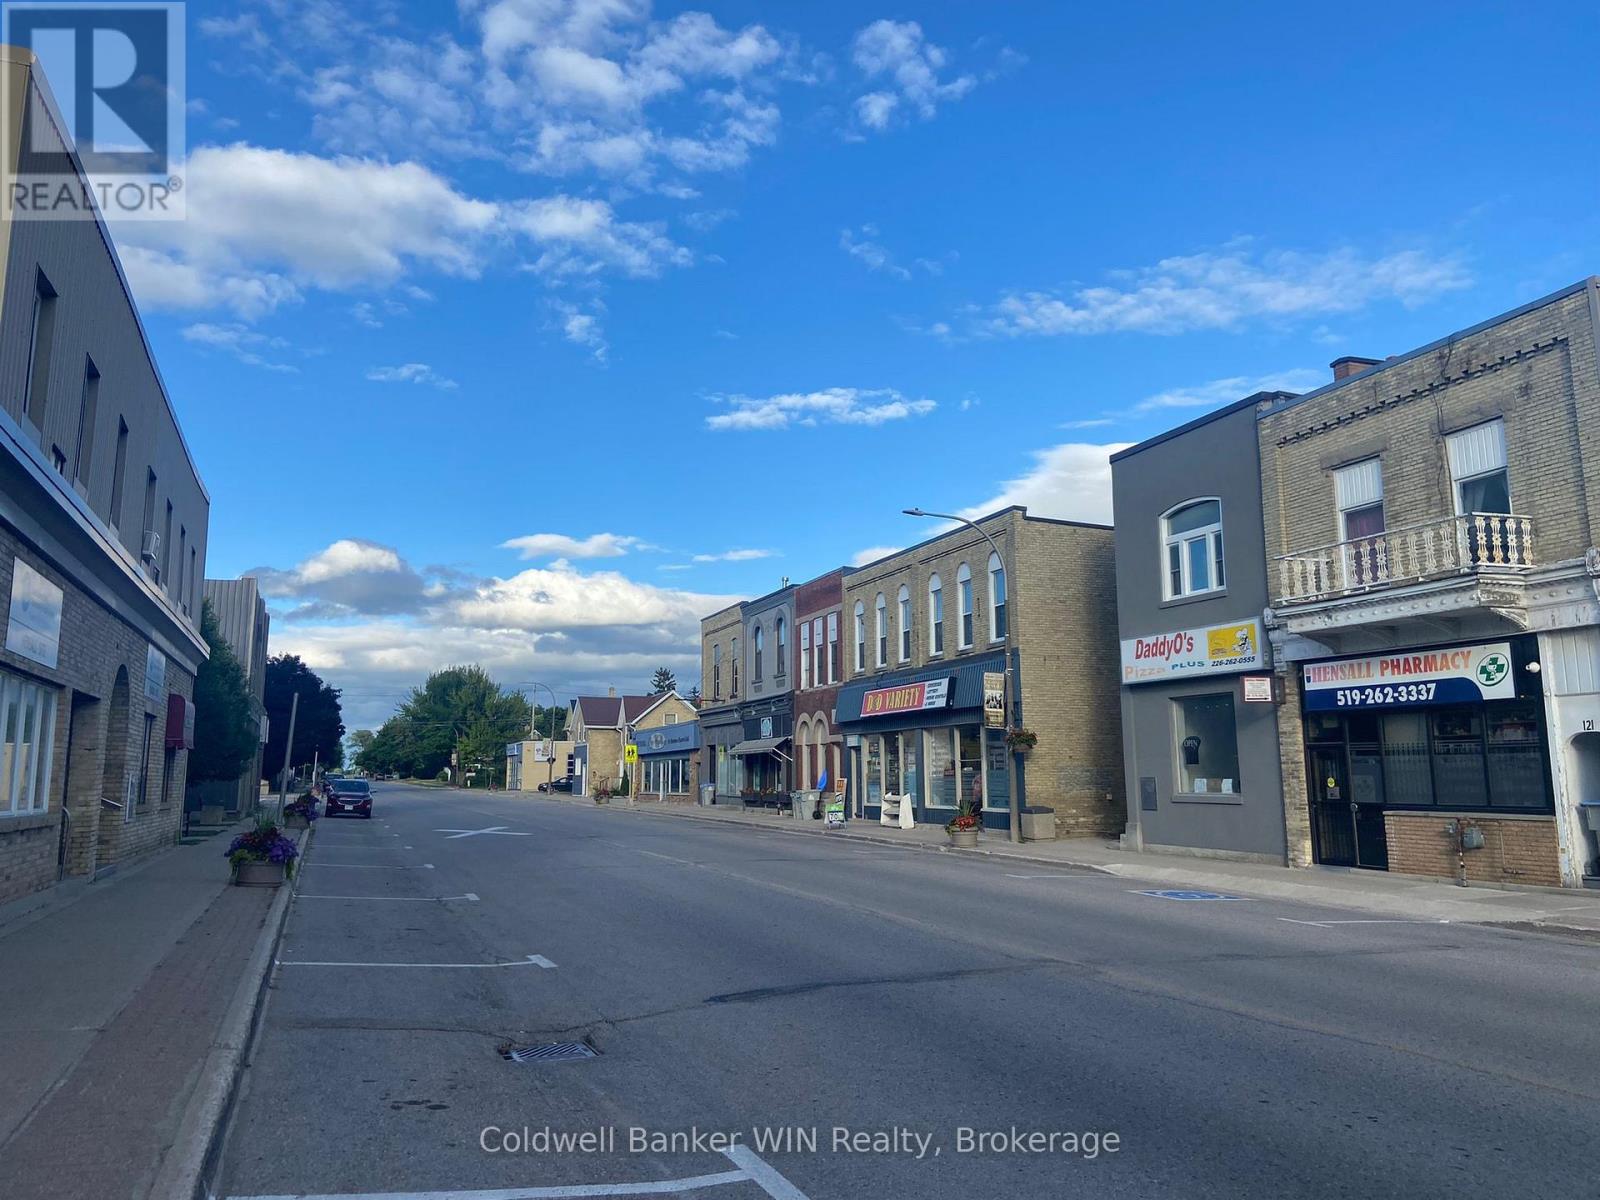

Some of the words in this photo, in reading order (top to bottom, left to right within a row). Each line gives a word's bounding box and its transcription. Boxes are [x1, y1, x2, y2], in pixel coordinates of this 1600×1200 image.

[1135, 632, 1194, 661] DaddyO's
[1171, 661, 1205, 670] PLUS
[1211, 655, 1256, 667] 226-262-0555
[1312, 661, 1374, 683] HENSALL
[1379, 650, 1472, 677] PHARMACY
[885, 687, 921, 710] VARIETY
[1336, 683, 1437, 706] 519-262-3337
[1582, 719, 1595, 731] 121
